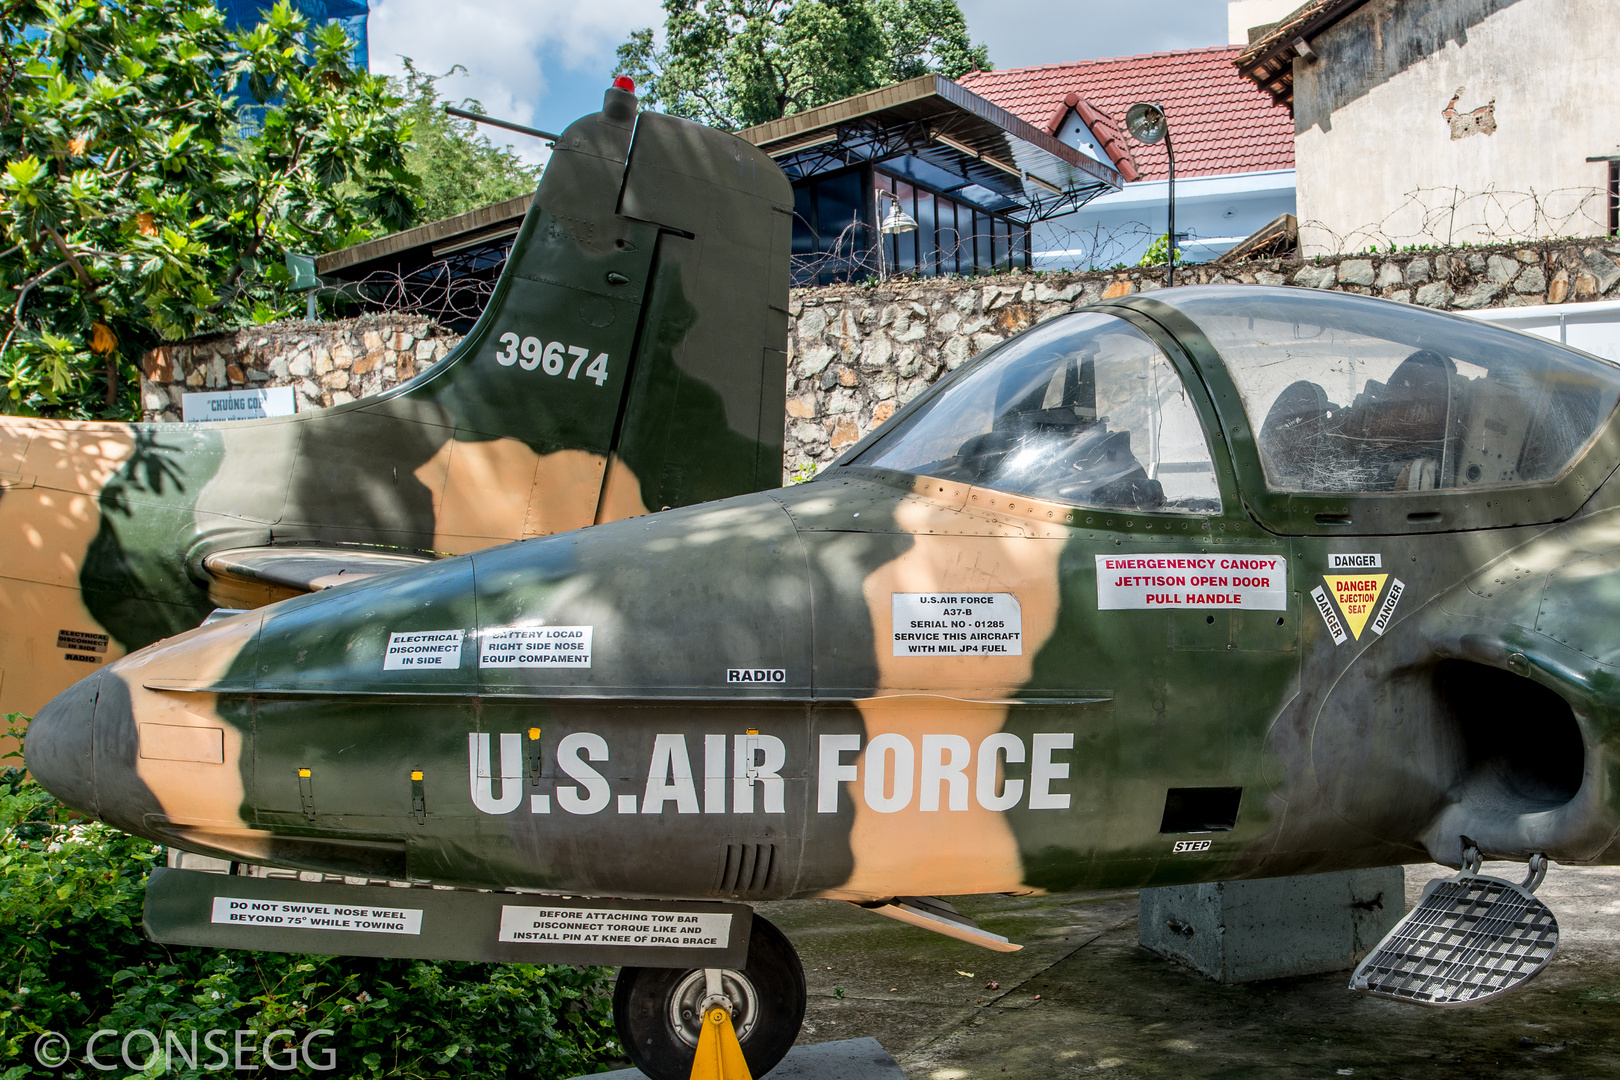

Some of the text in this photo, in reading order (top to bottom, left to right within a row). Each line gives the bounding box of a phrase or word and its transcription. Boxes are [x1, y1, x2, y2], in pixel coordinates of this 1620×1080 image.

[496, 332, 609, 386] 39674
[1105, 559, 1277, 570] EMERGENENCY CANOPY
[1334, 555, 1376, 566] DANGER
[1115, 576, 1270, 587] JETTISON OPEN DOOR
[1336, 580, 1377, 592] DANGER
[1146, 594, 1242, 604] PULL HANDLE
[1340, 593, 1375, 603] EJECTION
[1348, 605, 1367, 614] SEAT
[1375, 584, 1403, 629] DANGER
[1315, 593, 1343, 639] DANGER
[951, 620, 966, 628] NO
[974, 620, 1005, 628] 01285
[60, 630, 107, 640] ELECTRICAL
[394, 635, 459, 643] ELECTRICAL
[970, 632, 1020, 640] AIRCRAFT
[58, 636, 108, 646] DISCONNECT
[390, 645, 459, 654] DISCONNECT
[489, 643, 523, 651] RIGHT
[66, 654, 96, 662] RADIO
[482, 655, 589, 663] EQUIP COMPAMENT
[729, 670, 785, 682] RADIO
[469, 732, 1074, 815] U.S.AIR FORCE
[1175, 842, 1210, 851] STEP
[230, 901, 407, 919] DO NOT SWIVEL NOSE WEEL
[230, 913, 284, 924] BEYOND
[310, 918, 350, 927] WHILE
[354, 920, 404, 931] TOWING
[539, 911, 699, 923] BEFORE ATTACHING TOW BAR
[533, 921, 604, 931] DISCONNECT
[606, 924, 650, 933] TORQUE
[680, 926, 702, 934] AND
[513, 932, 559, 940] INSTALL
[633, 935, 648, 943] OF
[650, 936, 680, 944] DRAG
